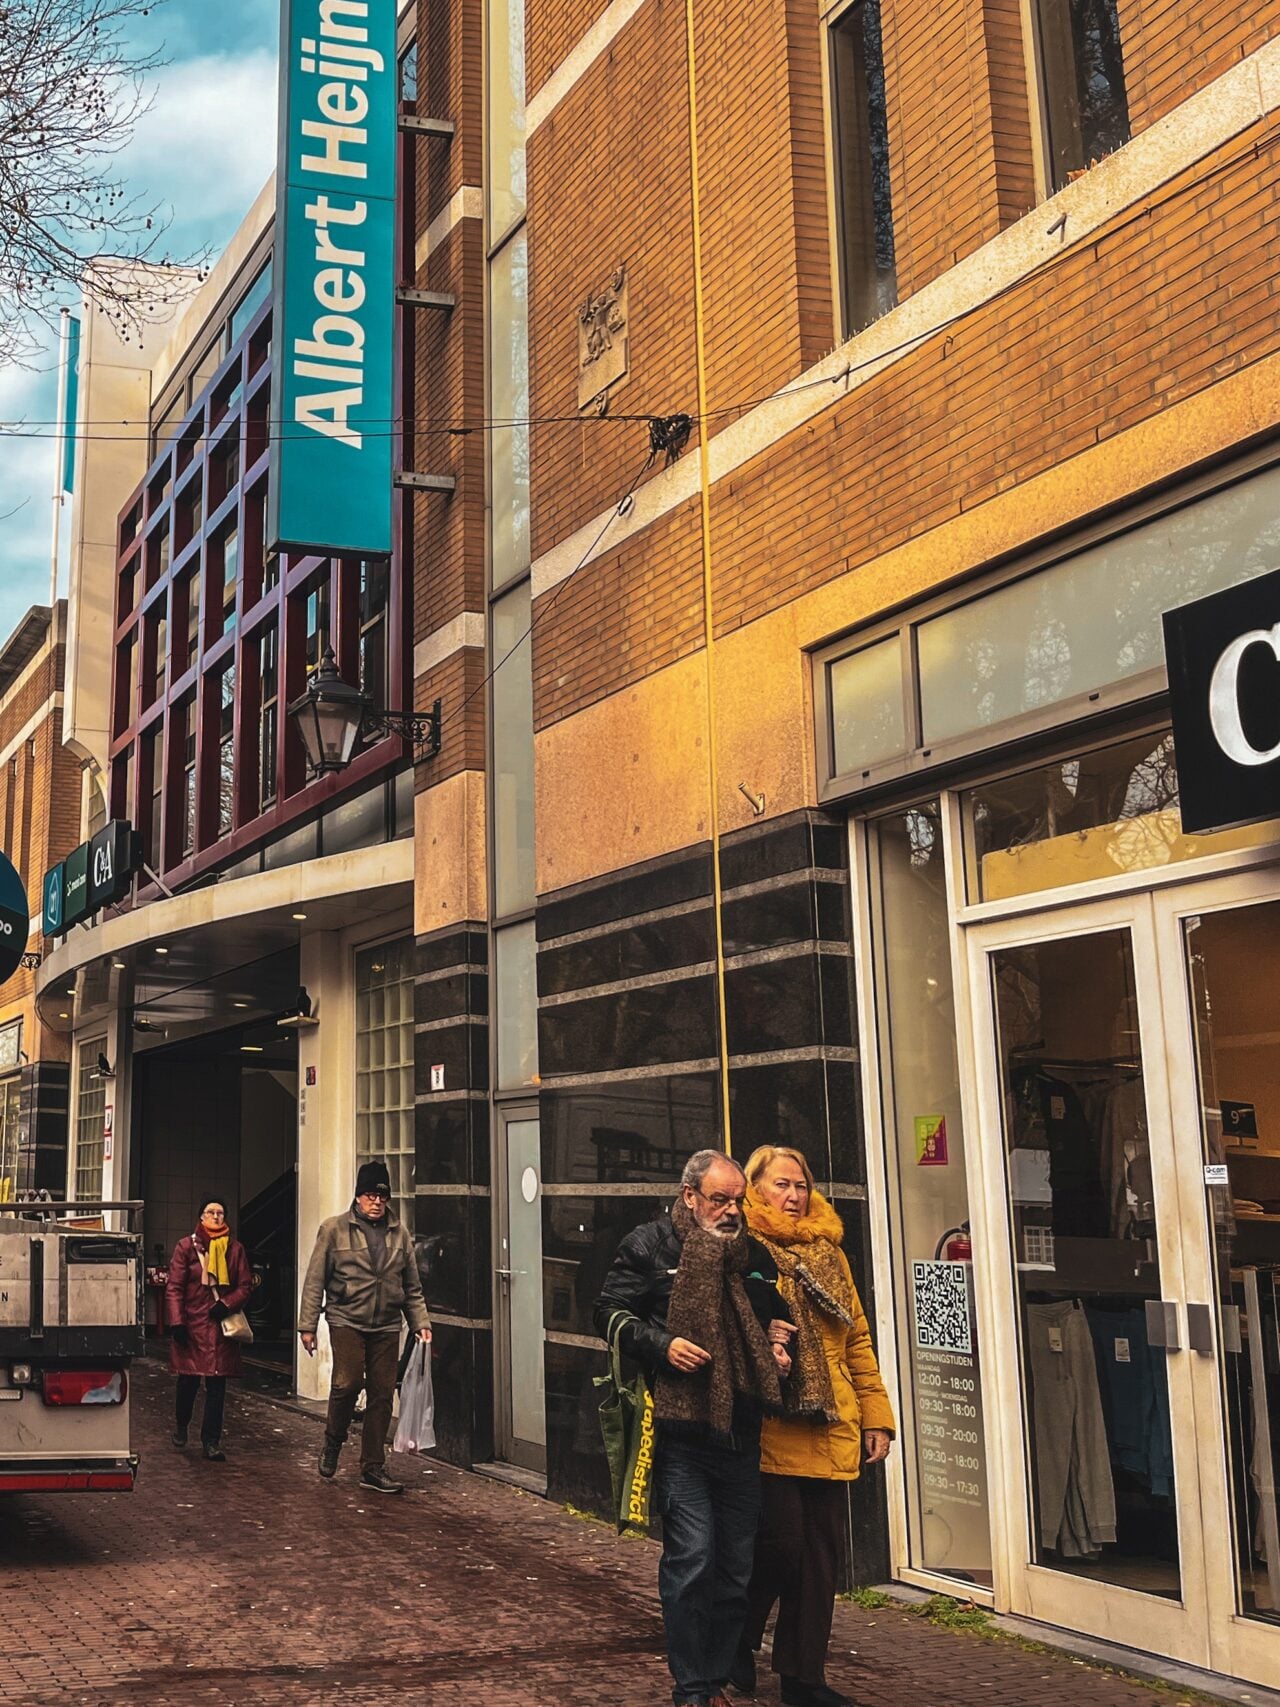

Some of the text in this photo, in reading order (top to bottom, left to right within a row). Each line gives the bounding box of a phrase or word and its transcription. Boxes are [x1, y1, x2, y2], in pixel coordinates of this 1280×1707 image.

[294, 0, 384, 451] Albert Heijn
[93, 840, 113, 888] C&A
[1230, 1110, 1240, 1124] 9
[918, 1373, 941, 1387] 12:00
[950, 1377, 975, 1392] 18:00
[920, 1398, 944, 1412] 09:30
[951, 1402, 976, 1418] 18:00
[921, 1423, 945, 1438] 09:30
[952, 1428, 978, 1444] 20:00
[922, 1448, 946, 1463] 09:30
[954, 1454, 979, 1470] 18:00
[924, 1473, 948, 1489] 09:30
[956, 1480, 979, 1496] 17:30
